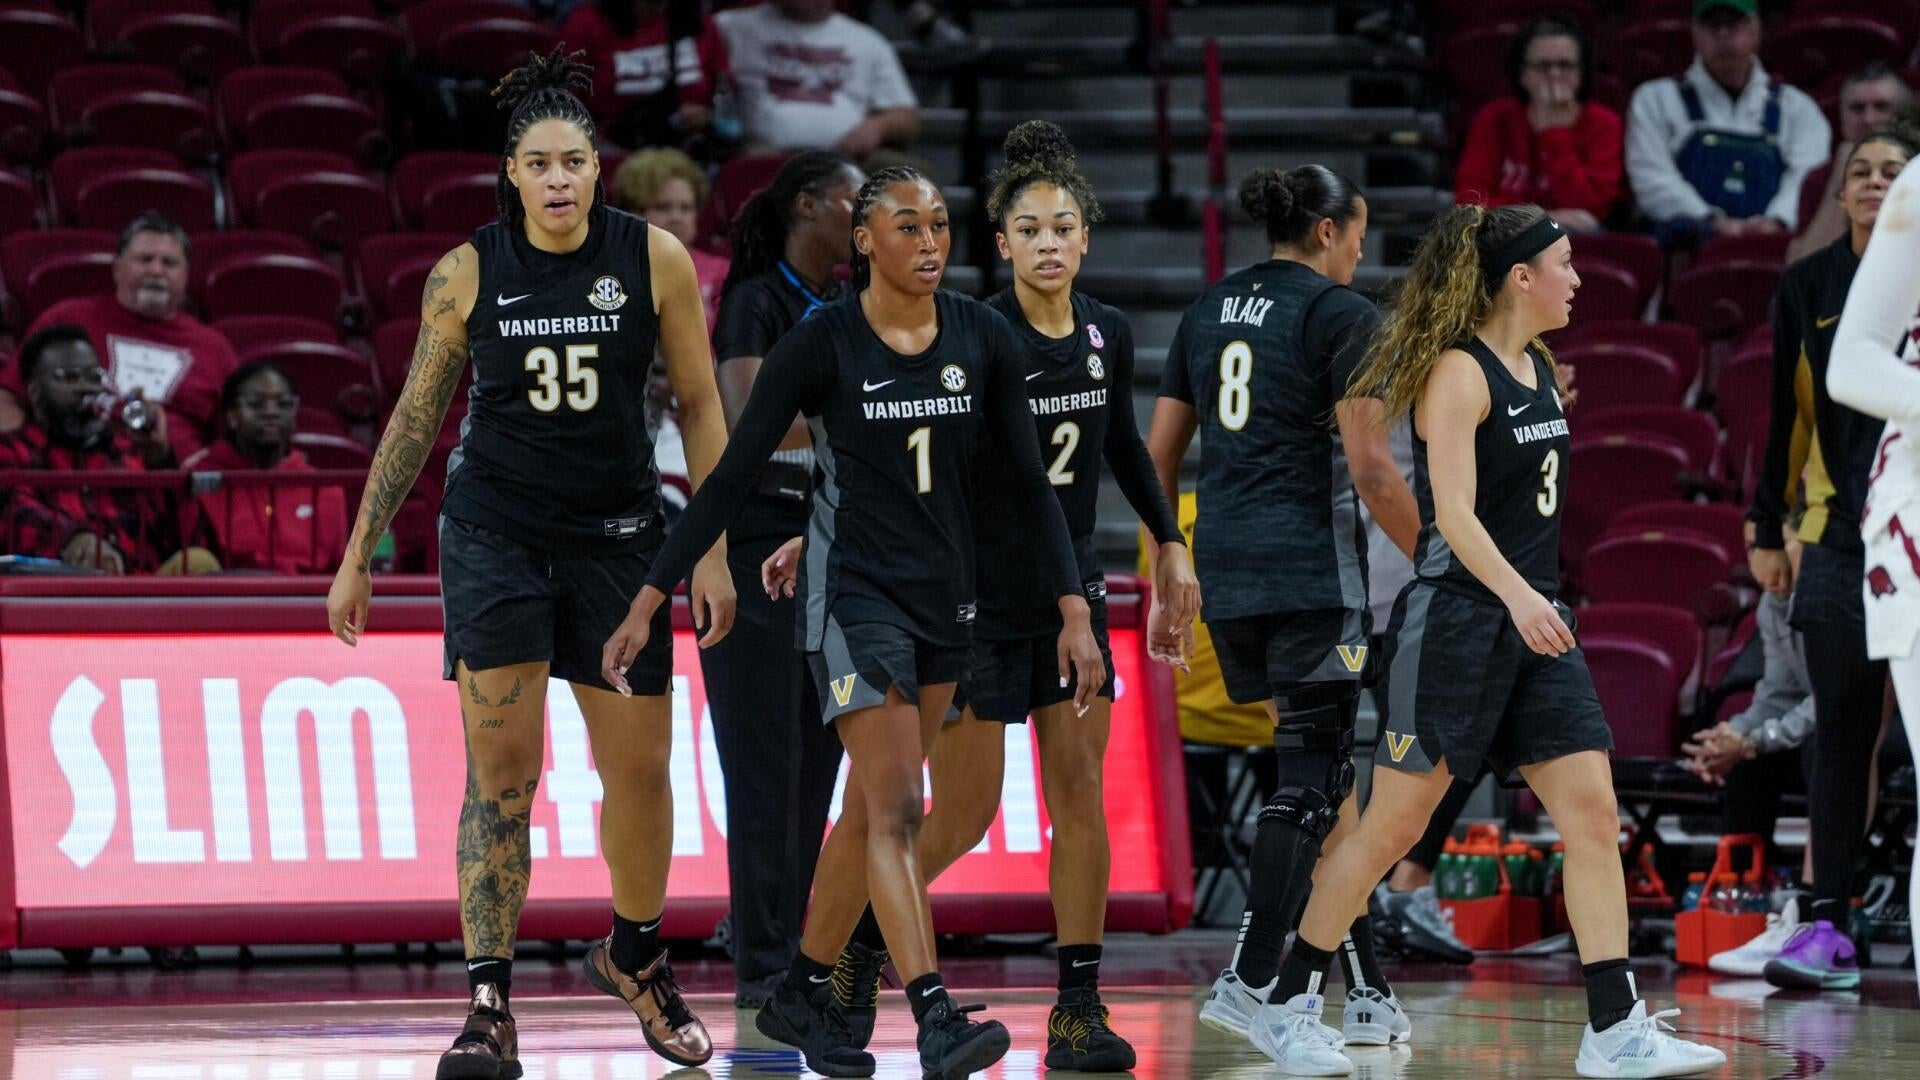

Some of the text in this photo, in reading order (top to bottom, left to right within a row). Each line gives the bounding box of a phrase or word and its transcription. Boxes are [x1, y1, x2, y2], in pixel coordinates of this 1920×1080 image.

[592, 298, 623, 310] GRADUATE
[595, 277, 620, 302] SEC
[498, 314, 621, 337] VANDERBILT
[1220, 297, 1275, 328] BLACK
[524, 343, 600, 413] 35
[942, 366, 966, 391] SEC
[1218, 340, 1253, 432] 8
[862, 394, 972, 420] VANDERBILT
[1028, 388, 1107, 416] ANDERBILT
[907, 426, 932, 494] 1
[1046, 421, 1080, 486] 2
[1537, 448, 1559, 517] 3
[1335, 645, 1368, 672] V
[830, 672, 857, 707] V
[1385, 730, 1417, 762] V
[49, 673, 419, 869] SLIM
